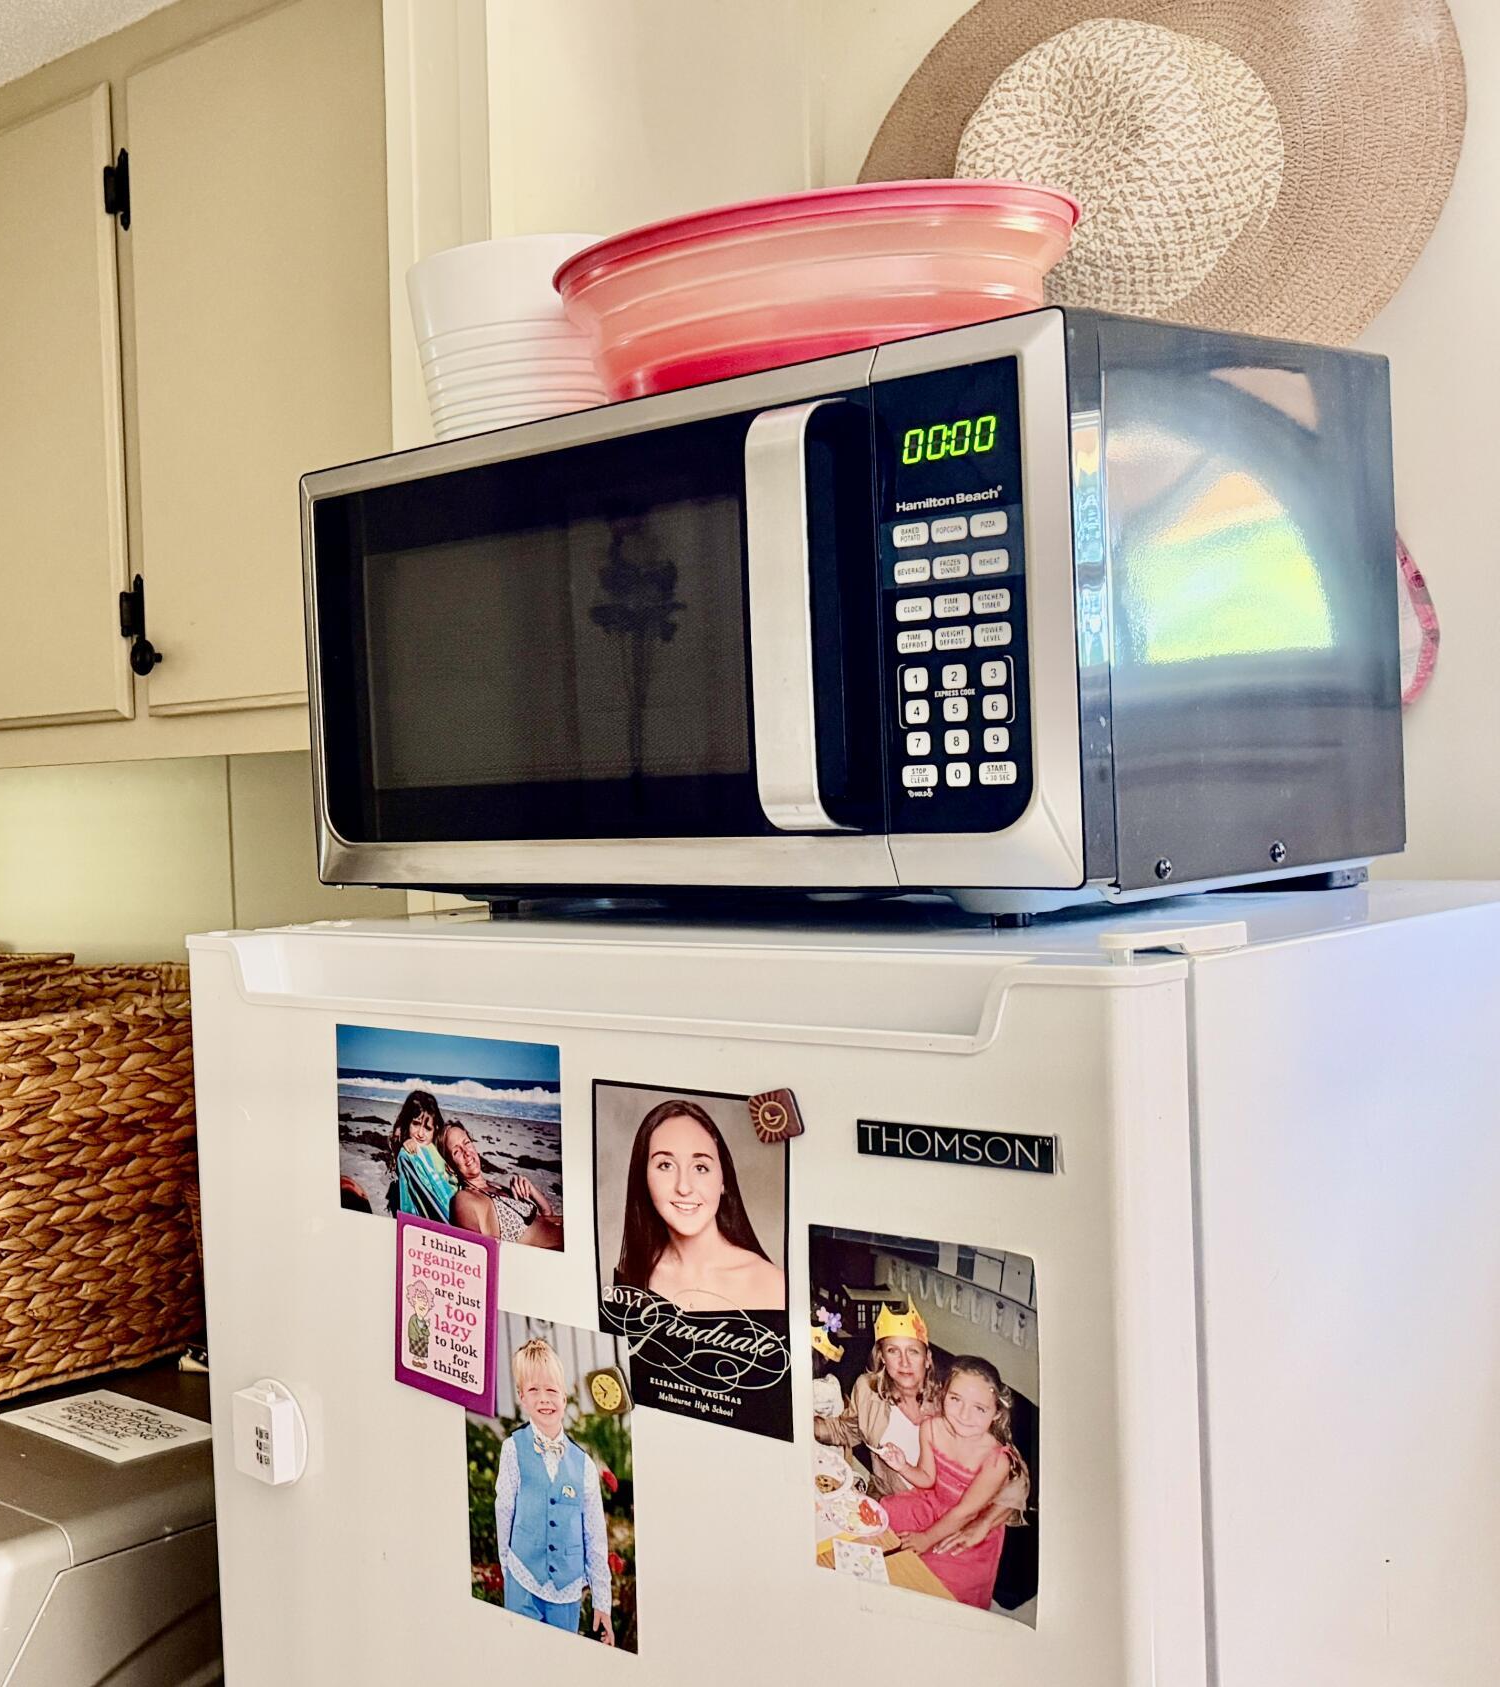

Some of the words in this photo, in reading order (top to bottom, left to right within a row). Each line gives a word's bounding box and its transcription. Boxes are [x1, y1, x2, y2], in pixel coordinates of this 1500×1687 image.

[902, 415, 996, 464] 00:00
[896, 491, 954, 512] Hamilton
[936, 525, 962, 534] POPCORN
[980, 520, 995, 528] PIZZA
[897, 567, 926, 576] BEVERAGE
[941, 630, 964, 638] WEIGHT
[902, 641, 927, 649] DEFROST
[913, 675, 918, 684] 1
[951, 672, 958, 682] 2
[990, 668, 997, 678] 3
[913, 706, 920, 716] 4
[952, 704, 958, 714] 5
[991, 701, 998, 712] 6
[915, 738, 921, 748] 7
[953, 736, 960, 746] 8
[992, 734, 999, 745] 9
[955, 769, 961, 779] 0
[859, 1123, 1039, 1169] THOMSON
[422, 1235, 426, 1246] I
[430, 1237, 467, 1258] think
[408, 1247, 482, 1279] organized
[412, 1263, 466, 1290] people
[434, 1287, 454, 1300] are
[456, 1292, 481, 1309] just
[603, 1286, 643, 1308] 2017
[445, 1302, 477, 1327] too
[434, 1314, 472, 1343] lazy
[628, 1301, 787, 1358] Graduate
[435, 1335, 447, 1347] to
[450, 1339, 478, 1358] look
[452, 1354, 470, 1368] for
[433, 1360, 478, 1385] things.
[650, 1377, 697, 1395] ELISABETH
[658, 1391, 692, 1408] Melbourne
[694, 1399, 710, 1413] High
[711, 1404, 734, 1418] School
